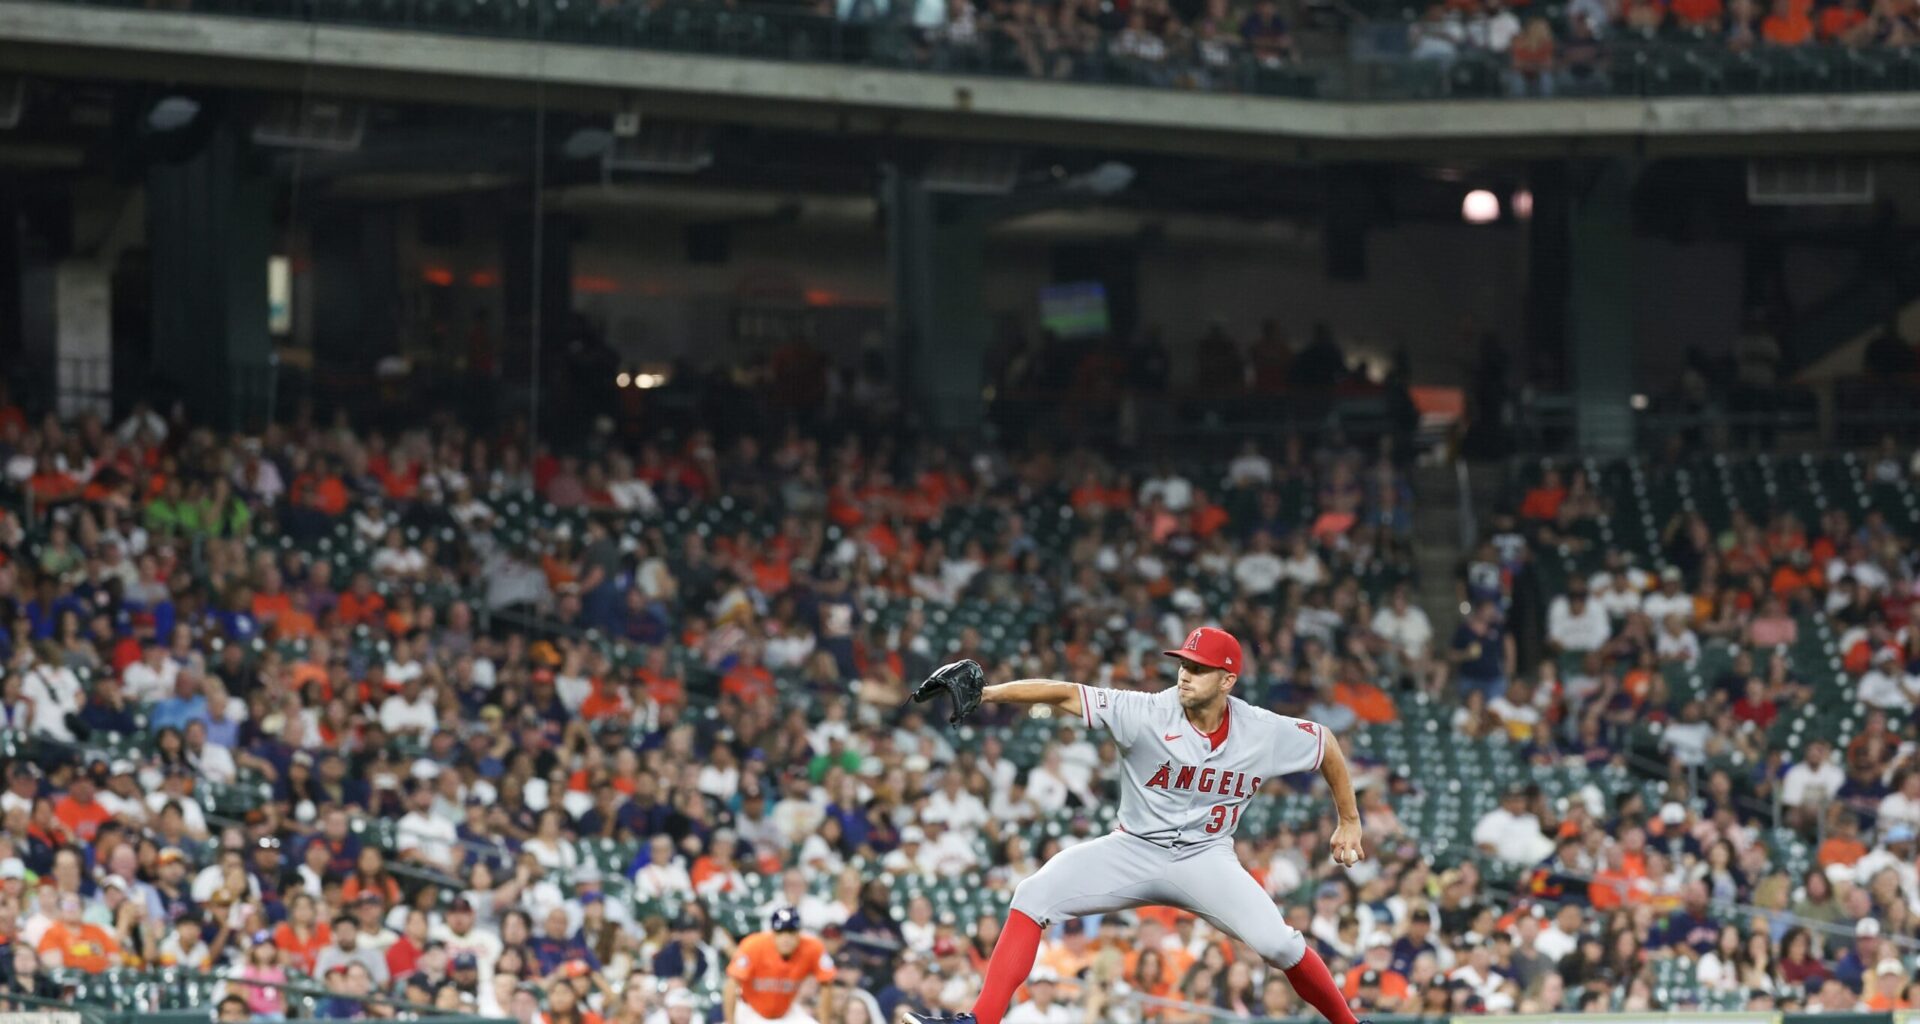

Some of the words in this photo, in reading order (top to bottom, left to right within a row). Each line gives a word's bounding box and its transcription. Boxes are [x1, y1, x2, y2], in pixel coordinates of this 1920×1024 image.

[1184, 632, 1202, 651] A
[1144, 760, 1262, 800] ANGELS
[1205, 804, 1240, 834] 31
